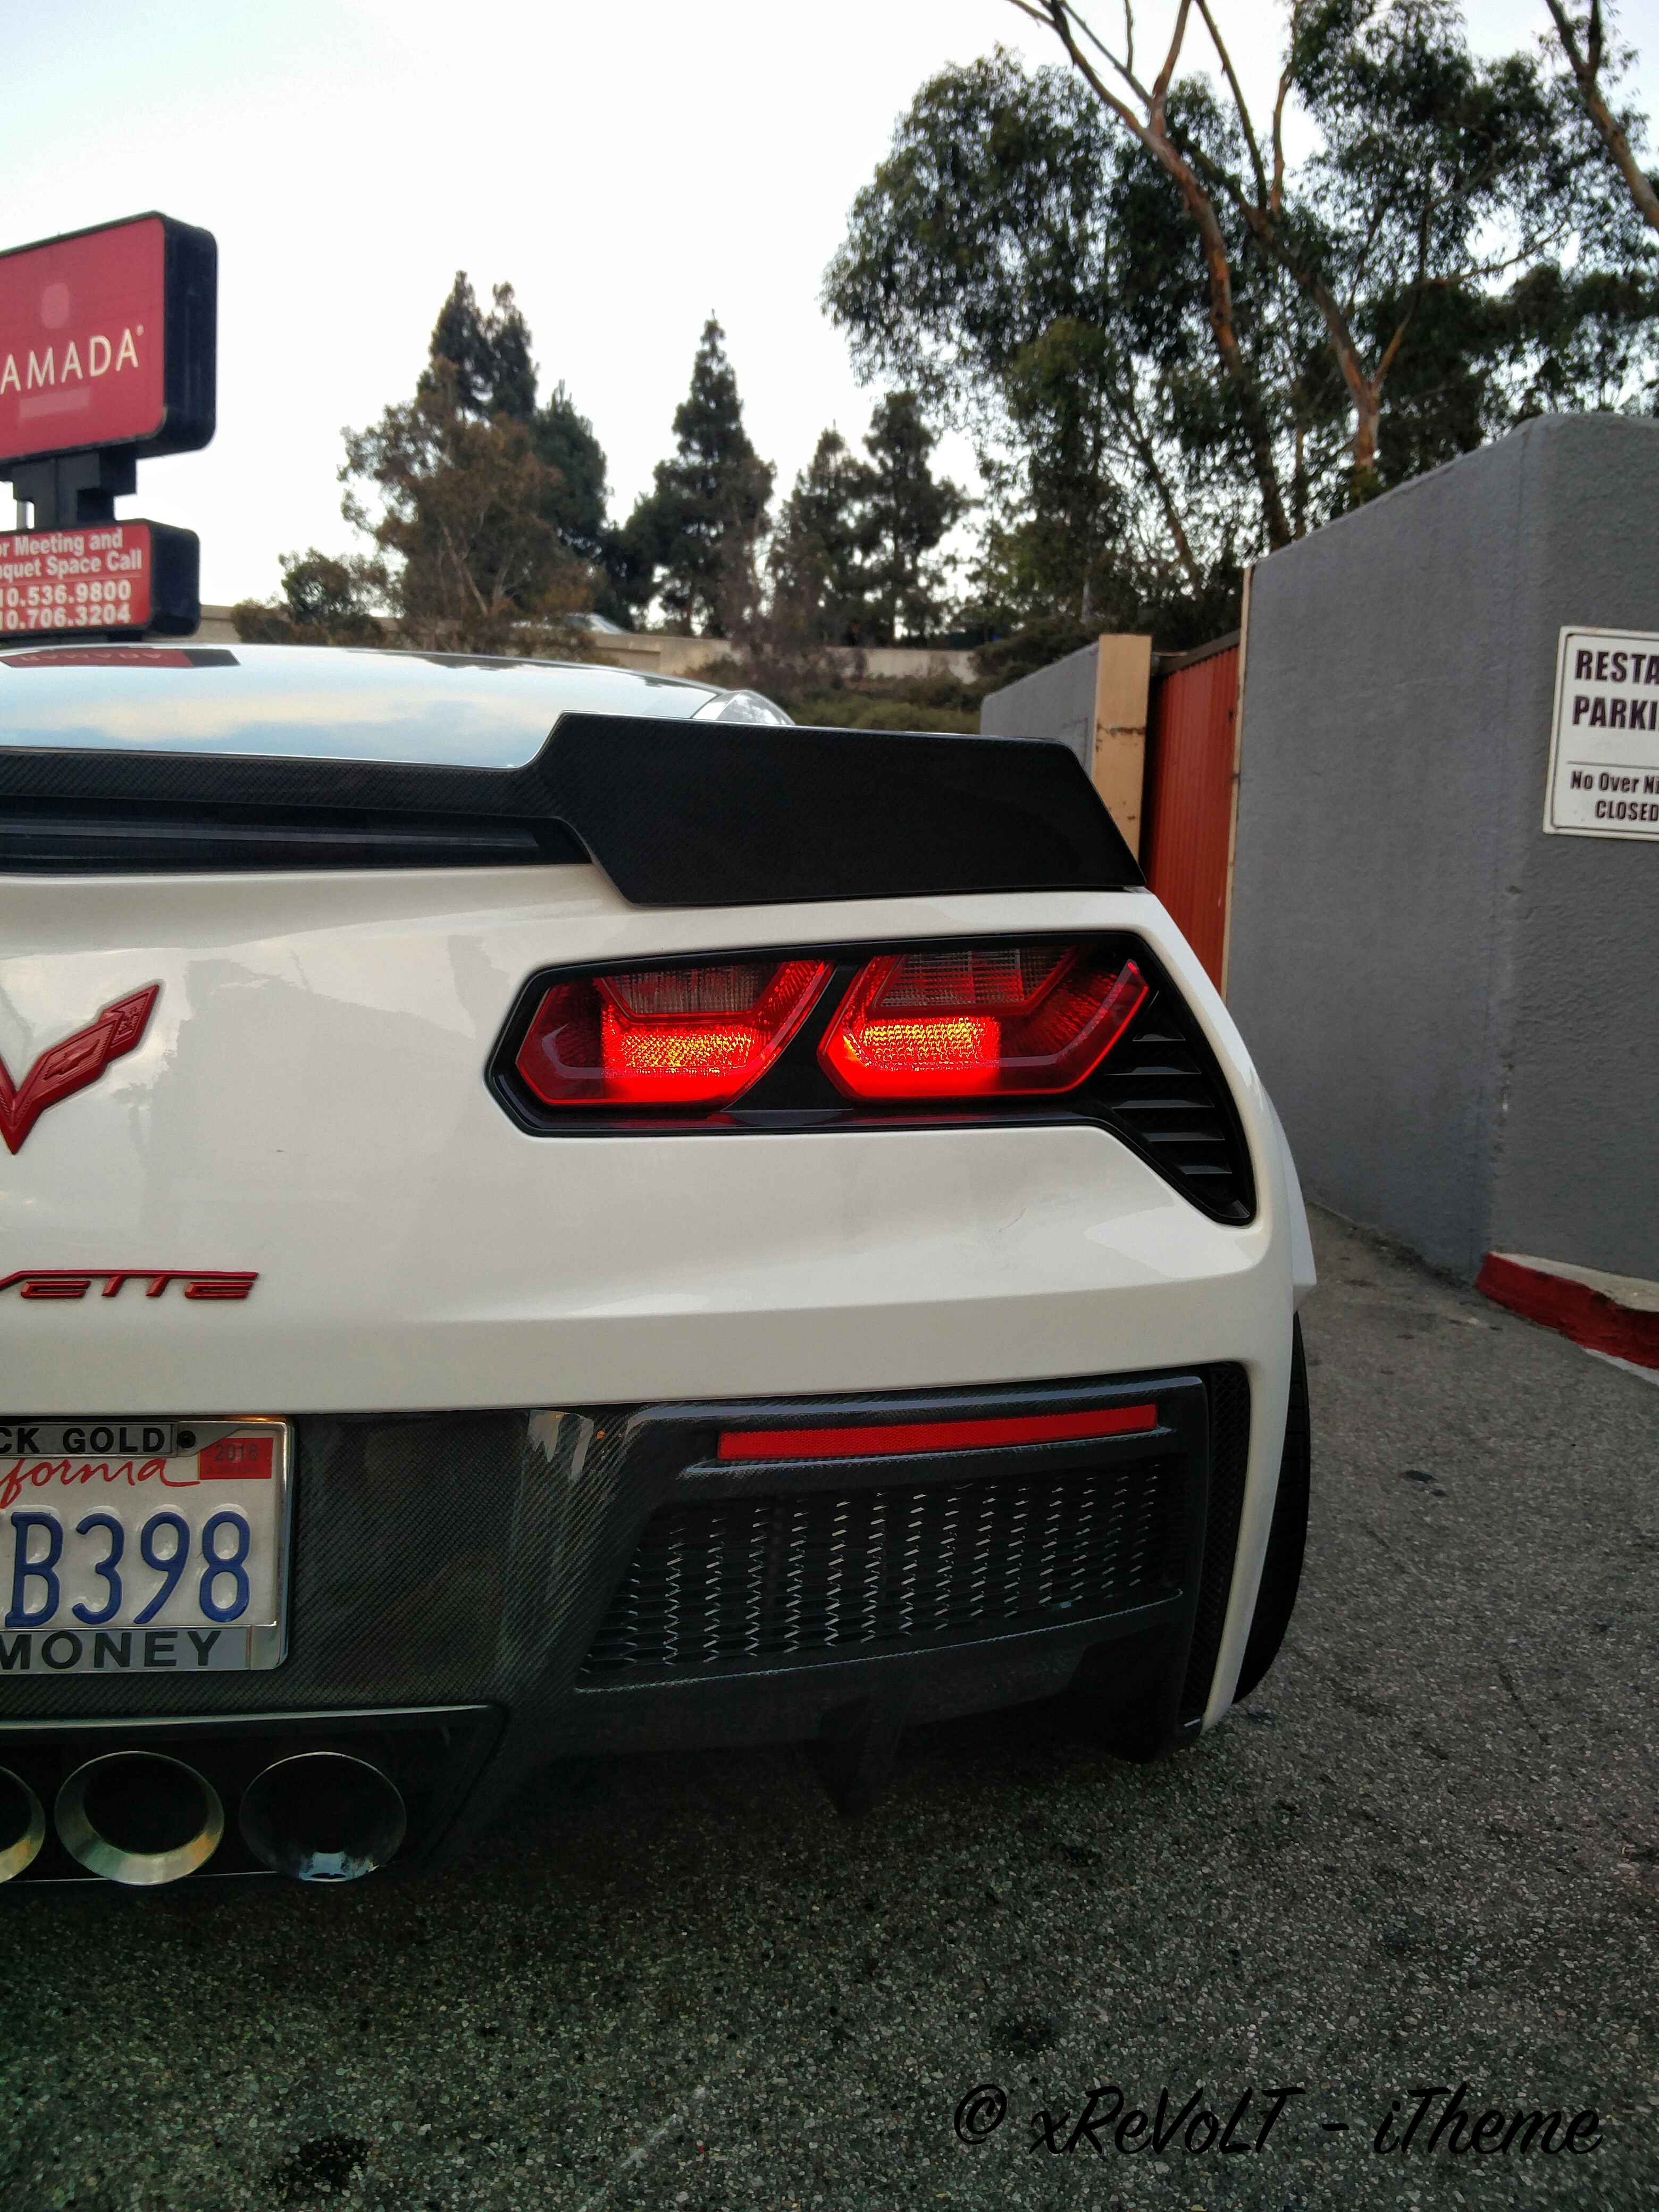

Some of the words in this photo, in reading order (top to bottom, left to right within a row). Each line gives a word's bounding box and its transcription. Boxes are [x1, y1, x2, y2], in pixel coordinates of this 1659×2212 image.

[0, 327, 139, 395] AMADA
[15, 533, 84, 556] Meeting
[89, 528, 123, 550] and
[0, 558, 42, 583] quet
[46, 555, 102, 580] Space
[107, 549, 142, 571] Call
[1575, 649, 1659, 684] RESTA
[1570, 770, 1593, 791] No
[1598, 772, 1639, 793] Over
[1595, 799, 1659, 822] CLOSED
[62, 1427, 165, 1454] GOLD
[214, 1444, 258, 1462] 2016
[5, 1511, 250, 1628] B398
[0, 1631, 222, 1670] MONEY
